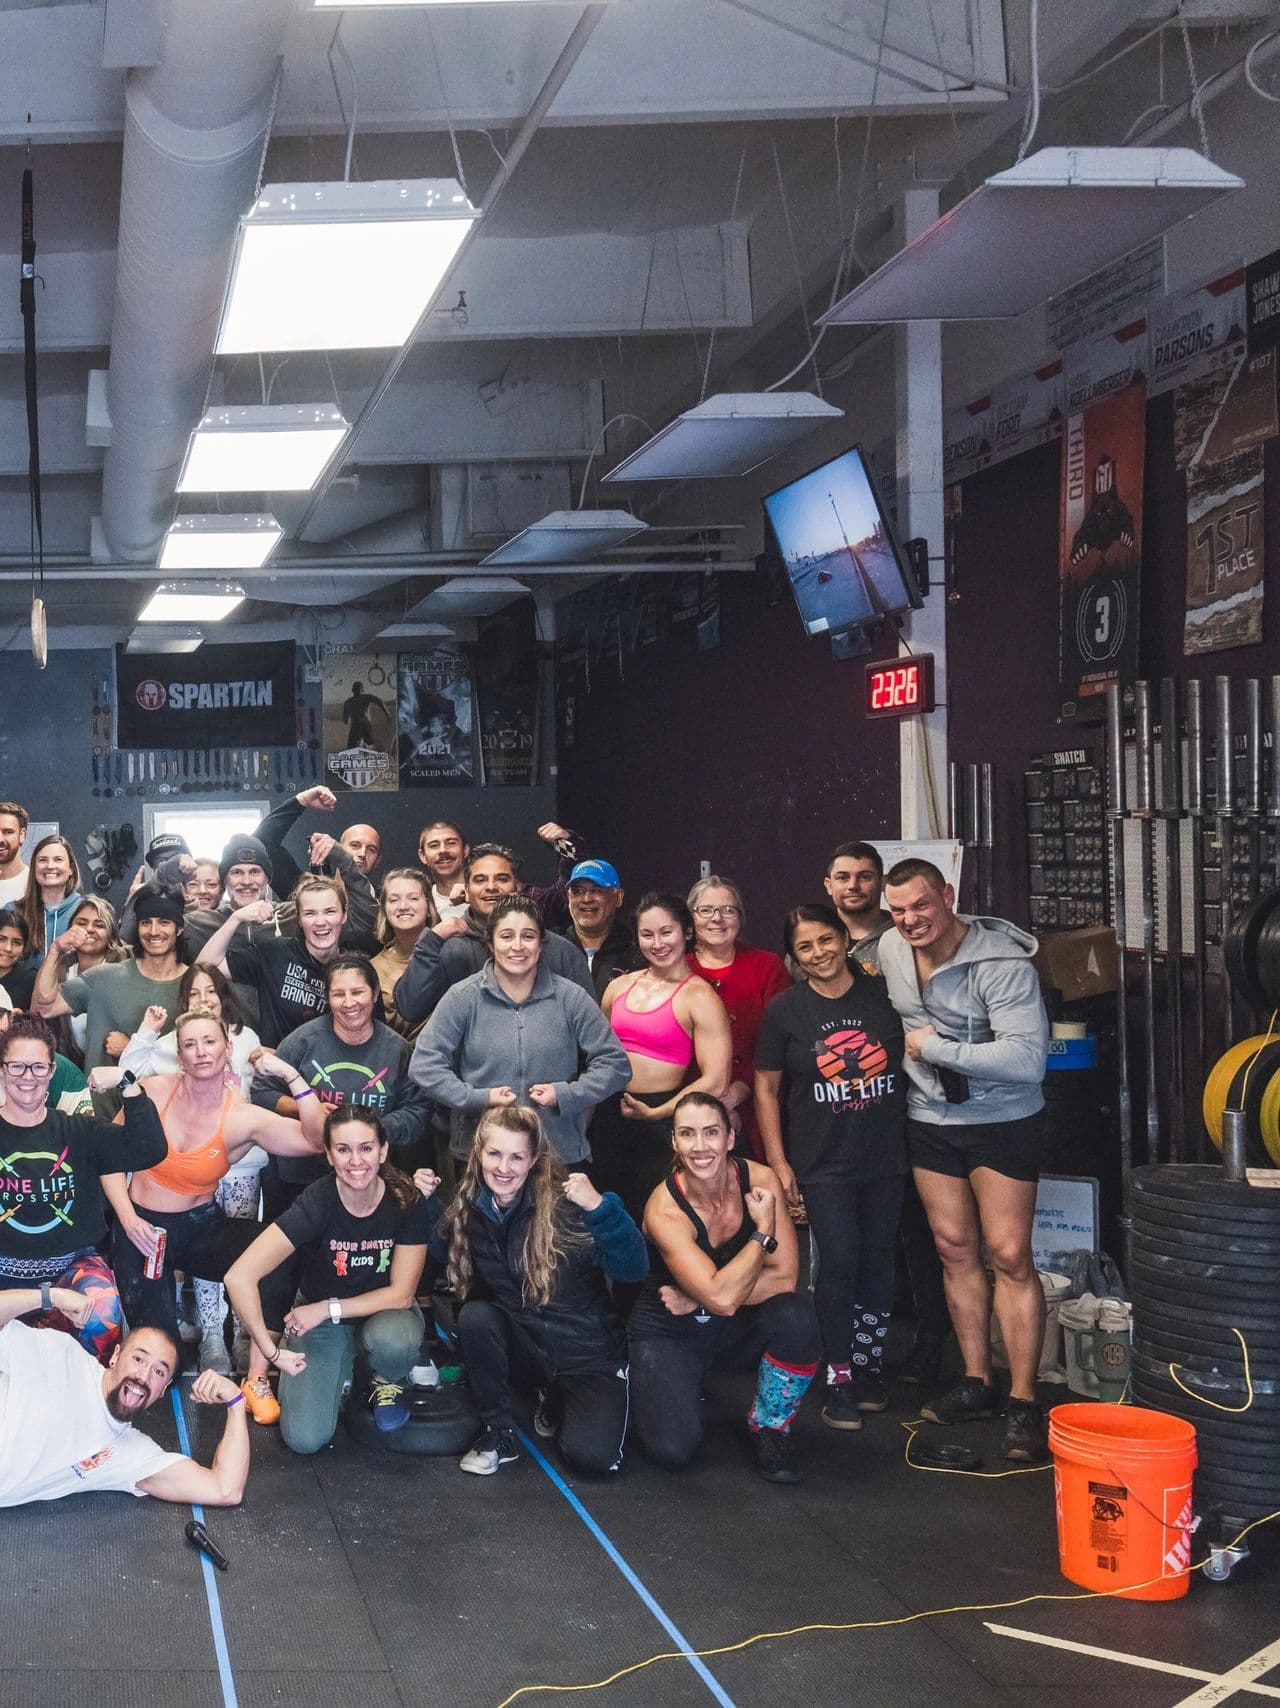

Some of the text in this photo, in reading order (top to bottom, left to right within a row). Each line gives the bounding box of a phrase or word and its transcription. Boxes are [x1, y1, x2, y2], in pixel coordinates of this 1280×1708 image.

[1155, 322, 1215, 370] PARSONS
[1068, 419, 1085, 501] THIRD
[1195, 502, 1260, 596] 1ST
[1217, 550, 1257, 581] PLACE
[1095, 595, 1110, 644] 3
[168, 680, 273, 710] SPARTAN
[871, 666, 918, 709] 2326
[418, 743, 452, 756] 2021
[1053, 749, 1086, 765] SNATCH
[329, 760, 389, 769] GAMES
[410, 769, 462, 777] SCALED MEN
[286, 962, 308, 981] USA
[281, 984, 316, 1007] BRING
[842, 1019, 862, 1027] 2022
[813, 1074, 895, 1103] ONE LIFE
[351, 1092, 388, 1108] LIFE
[40, 1174, 75, 1193] LIFE
[329, 1239, 359, 1252] SOUR
[350, 1256, 374, 1267] KIDS
